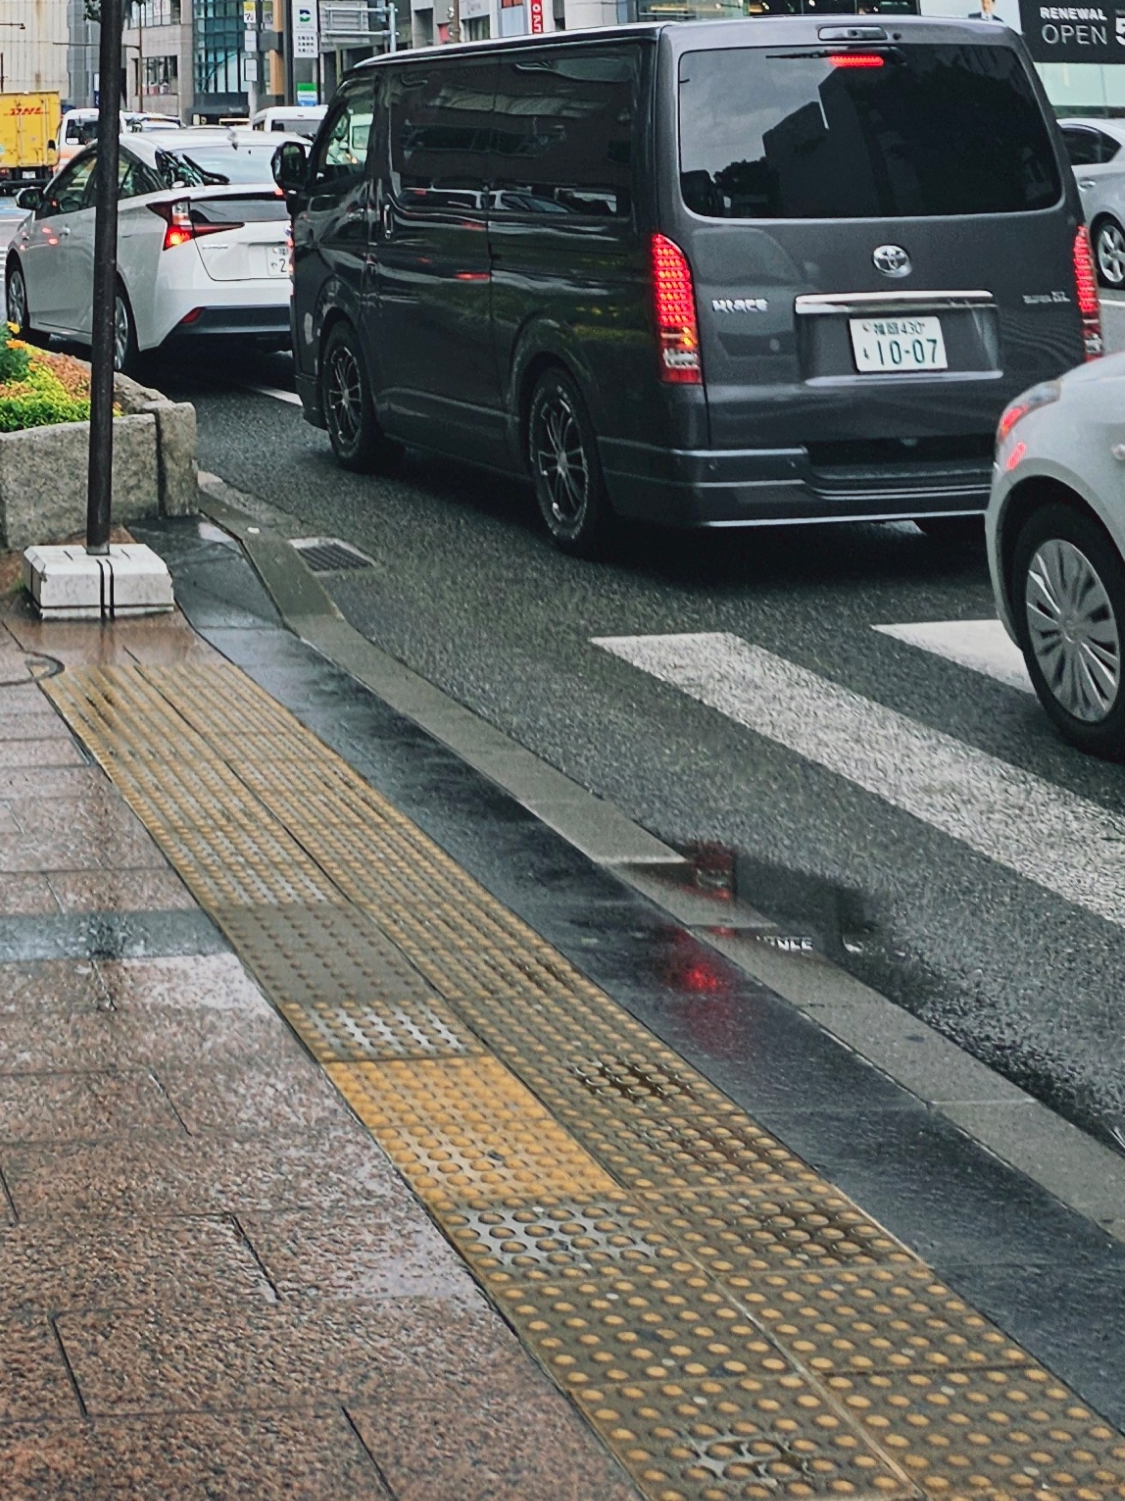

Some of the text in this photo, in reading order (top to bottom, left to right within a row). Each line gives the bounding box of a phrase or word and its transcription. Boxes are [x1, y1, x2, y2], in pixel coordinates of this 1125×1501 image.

[1040, 7, 1108, 20] RENEWAL
[1042, 24, 1108, 45] OPEN
[877, 339, 937, 367] 10-07
